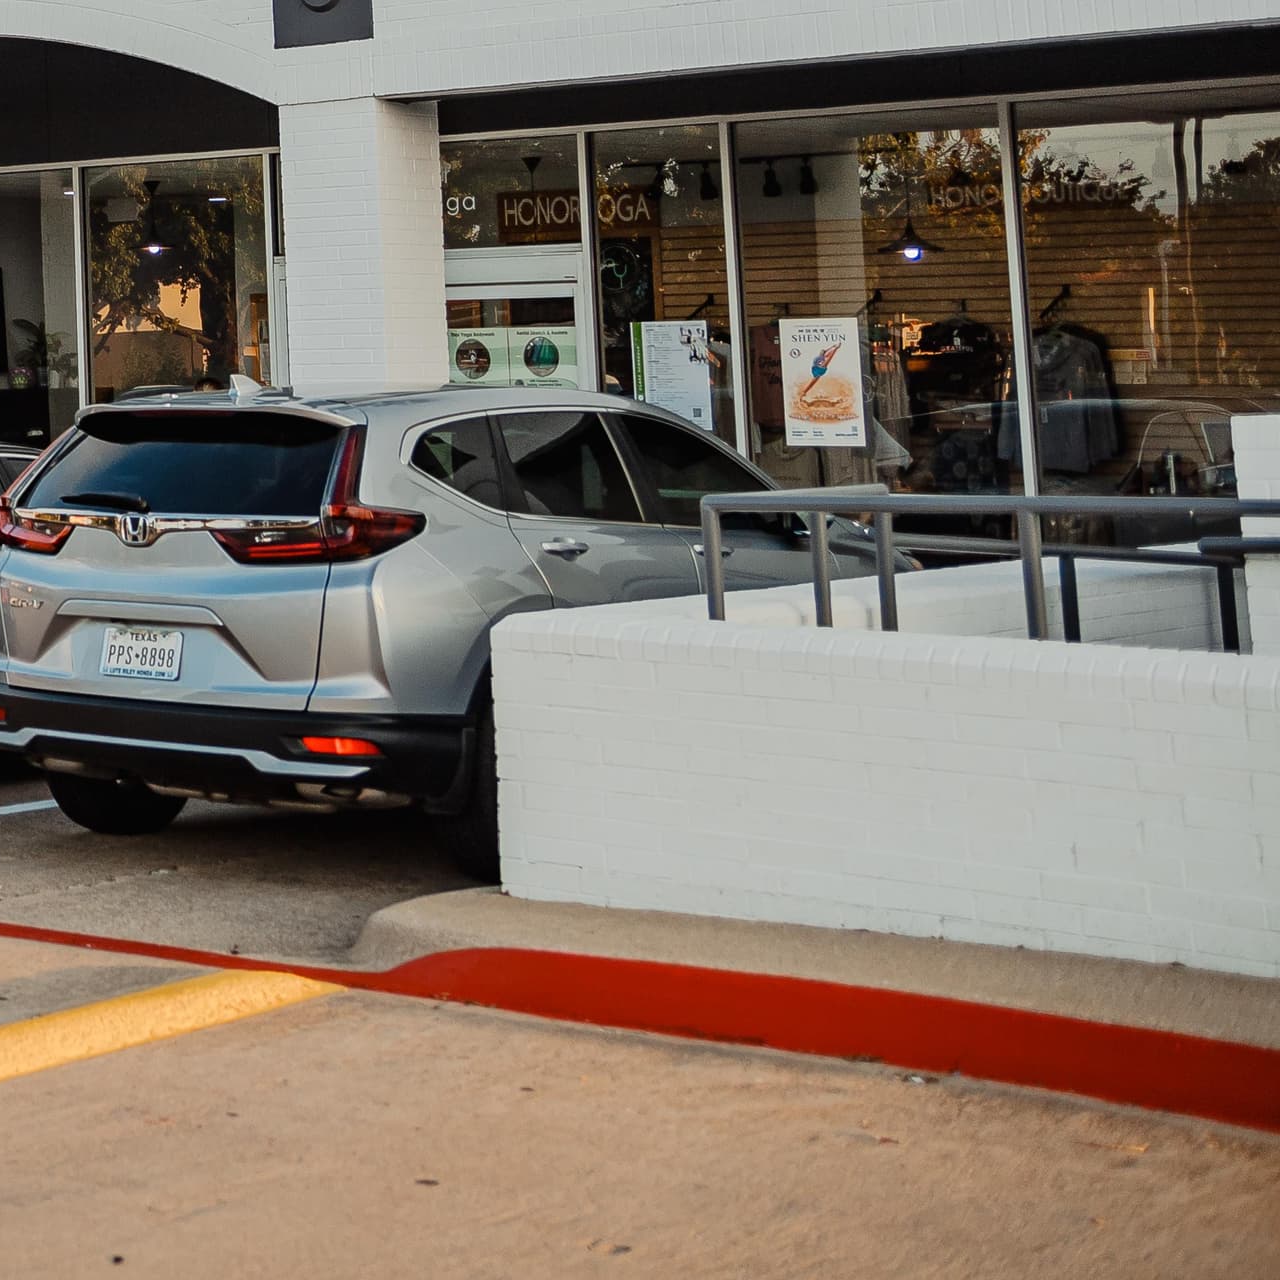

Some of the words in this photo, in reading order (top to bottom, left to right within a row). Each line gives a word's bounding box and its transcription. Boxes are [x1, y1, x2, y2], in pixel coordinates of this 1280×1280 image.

[446, 195, 476, 216] ga
[930, 184, 1002, 207] HONO
[597, 193, 651, 223] OGA
[792, 334, 821, 343] SHEN
[824, 333, 846, 342] YUN
[130, 632, 158, 643] TEXAS
